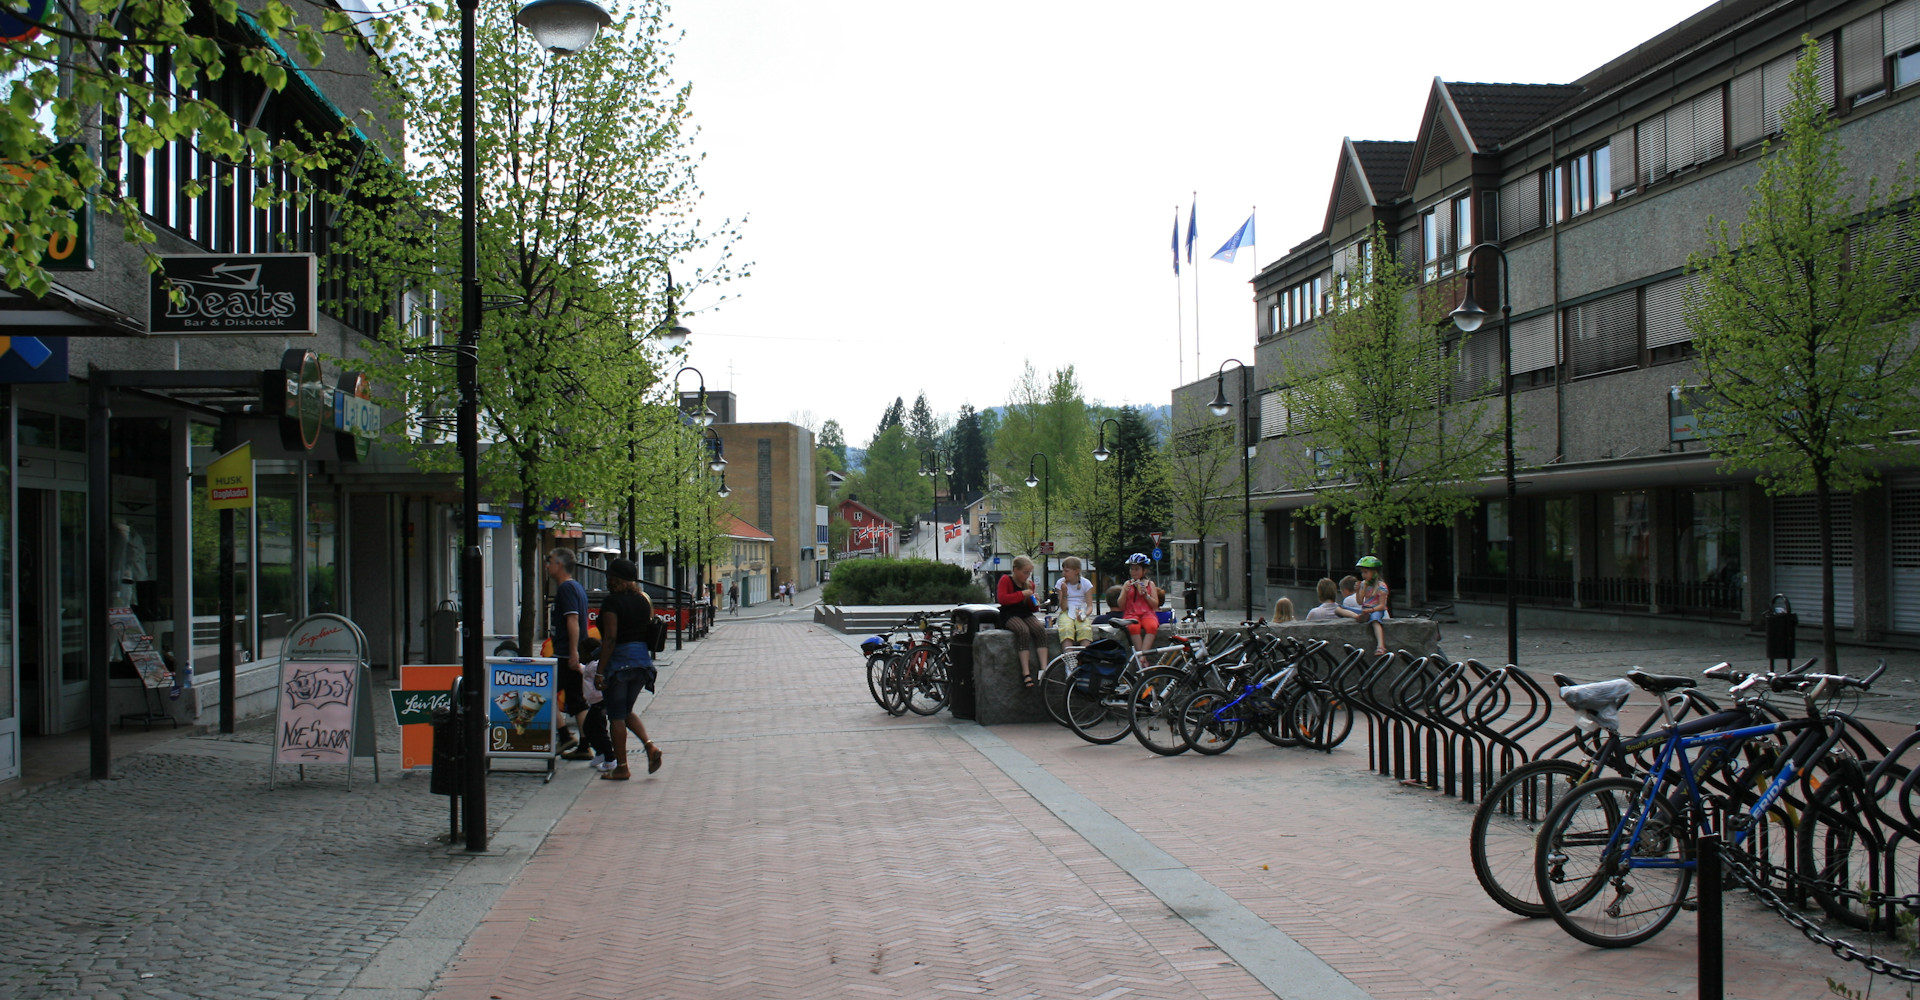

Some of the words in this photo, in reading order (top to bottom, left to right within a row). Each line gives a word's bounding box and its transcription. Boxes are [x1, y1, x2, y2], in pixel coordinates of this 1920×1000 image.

[165, 281, 296, 318] Beats
[184, 319, 206, 327] Bar
[209, 318, 220, 327] &
[224, 317, 285, 327] Diskotek
[215, 476, 243, 486] HUSK
[213, 488, 247, 499] Dagbladet
[401, 693, 431, 715] Leiv
[428, 693, 451, 711] Vid
[1625, 740, 1647, 752] South
[1751, 778, 1787, 820] ERIDA
